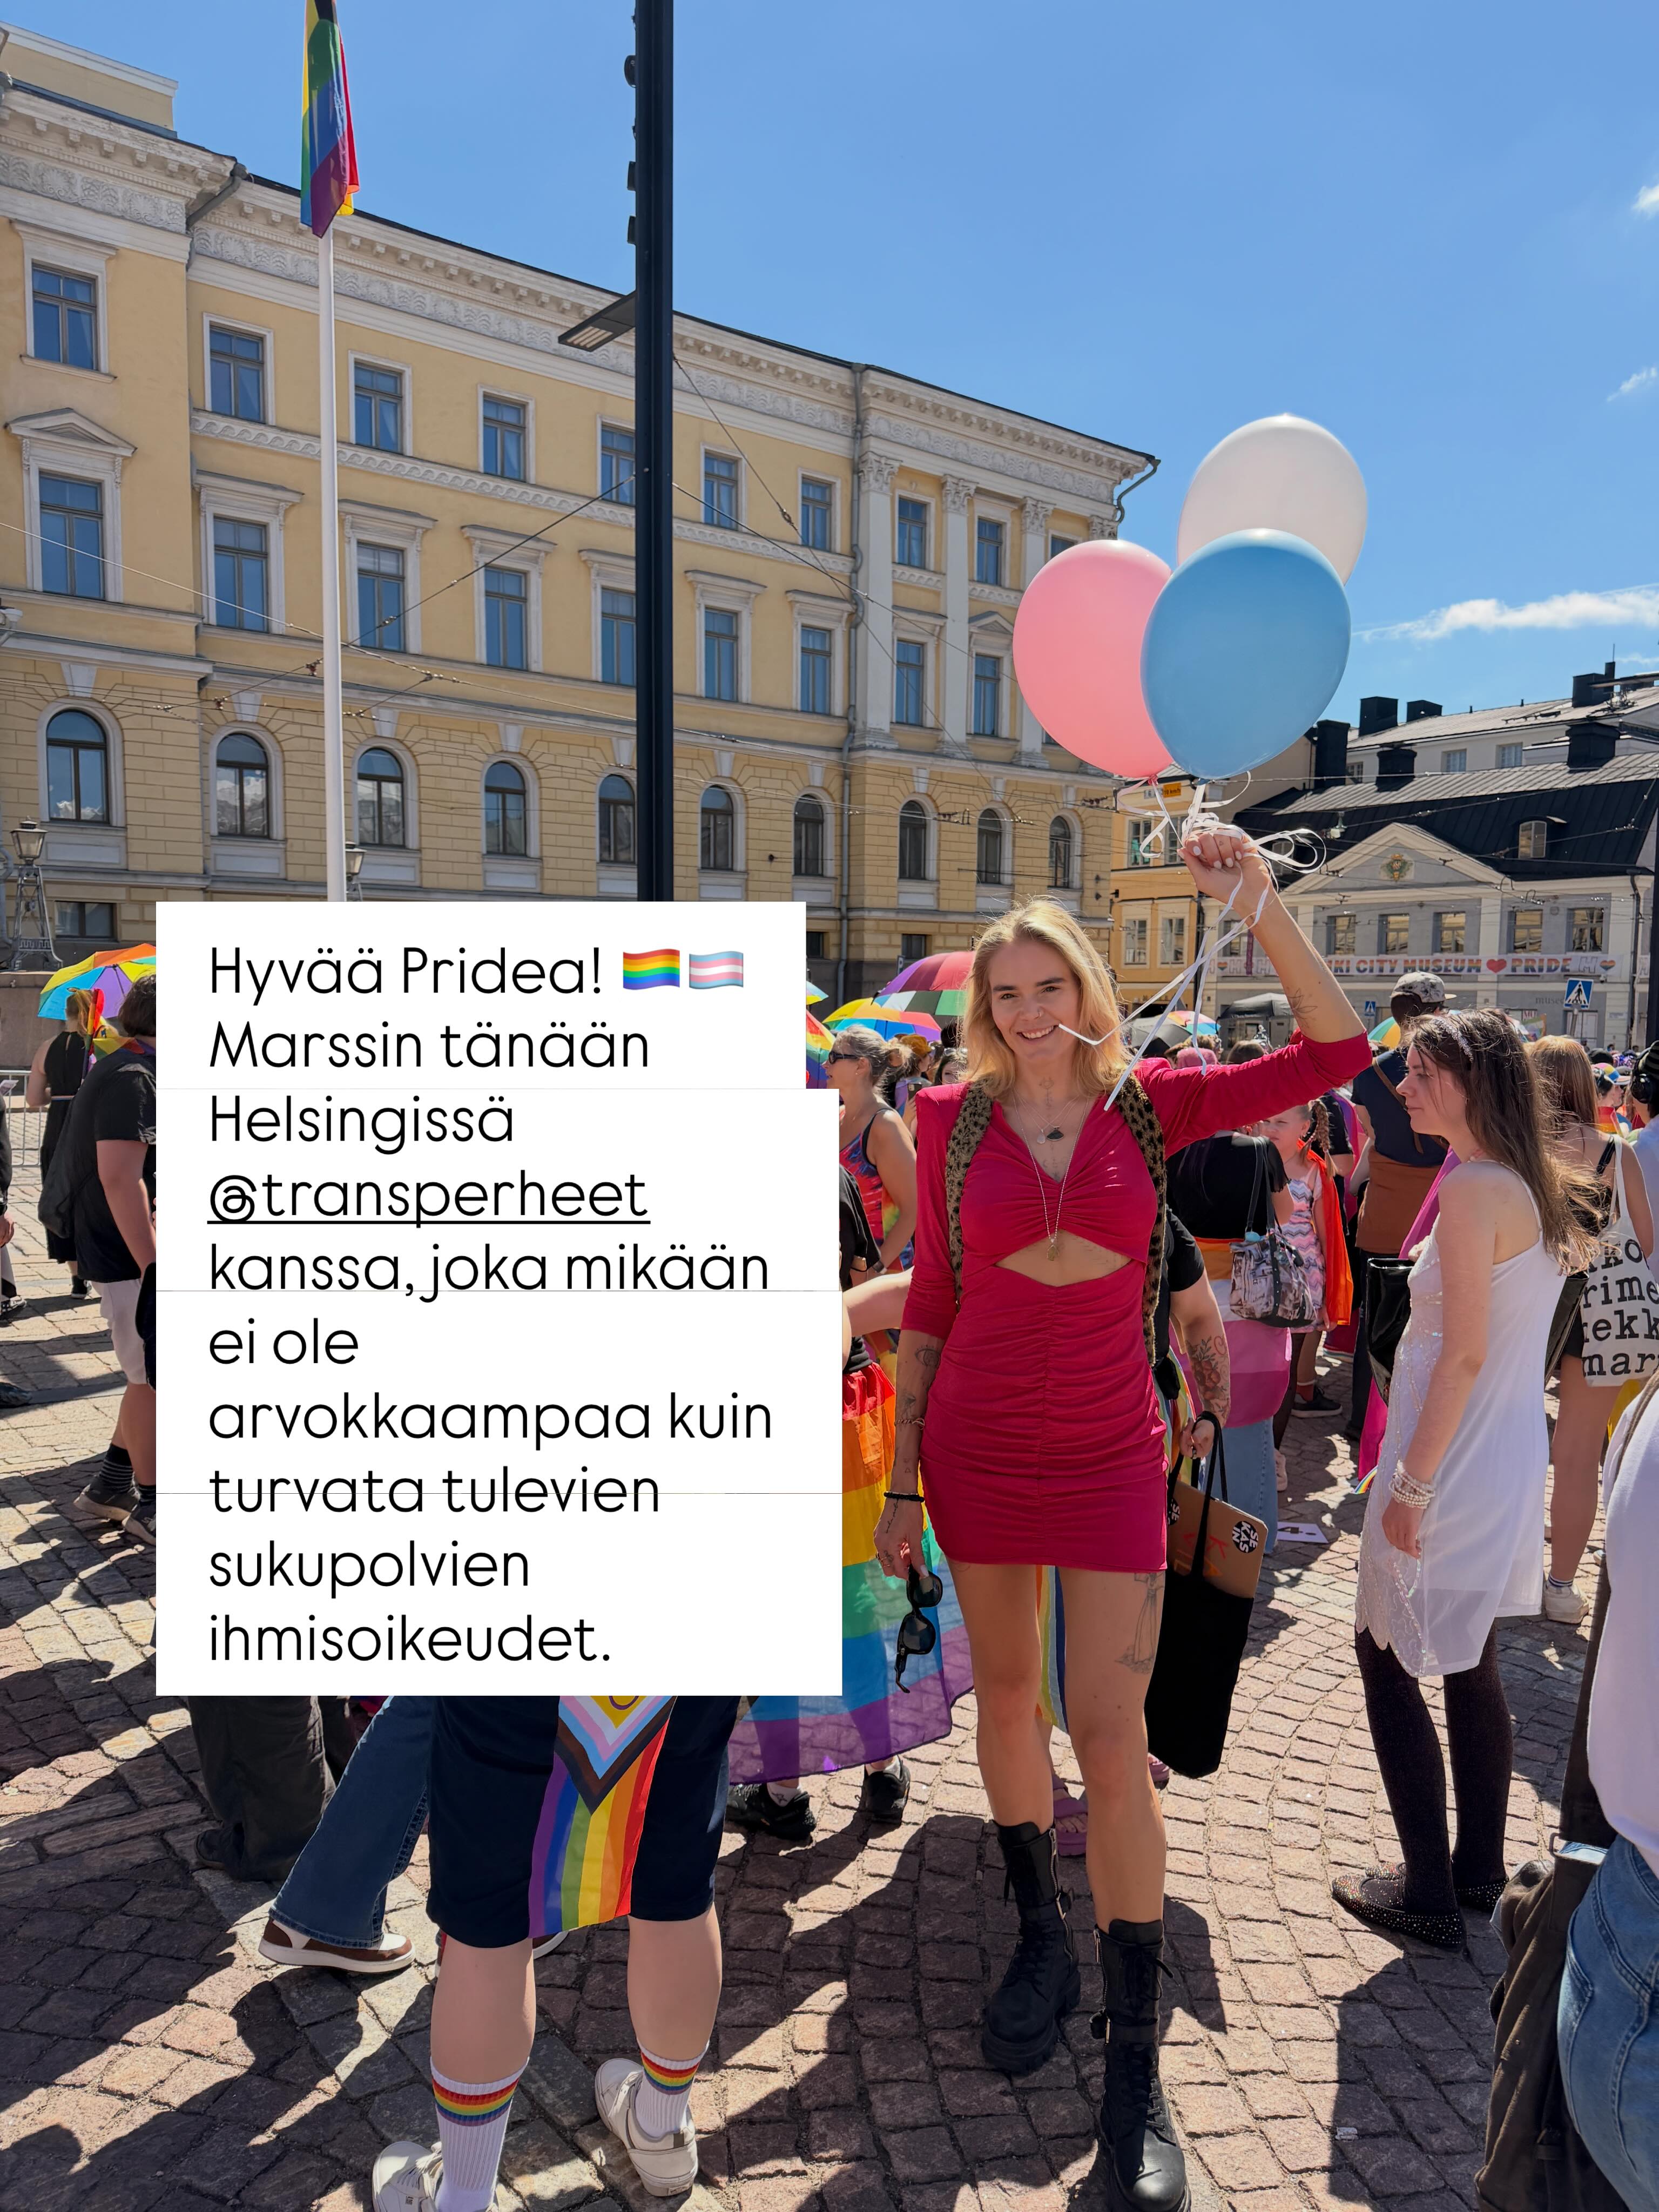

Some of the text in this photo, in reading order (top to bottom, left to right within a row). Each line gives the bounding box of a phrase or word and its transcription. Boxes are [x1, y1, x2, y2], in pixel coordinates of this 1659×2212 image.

[1355, 959, 1398, 973] CITY
[1403, 959, 1482, 973] MUSEUM
[1511, 957, 1573, 973] PRIDE
[1232, 1526, 1241, 1543] IN
[1239, 1521, 1251, 1553] KAS
[1249, 1529, 1259, 1548] SE
